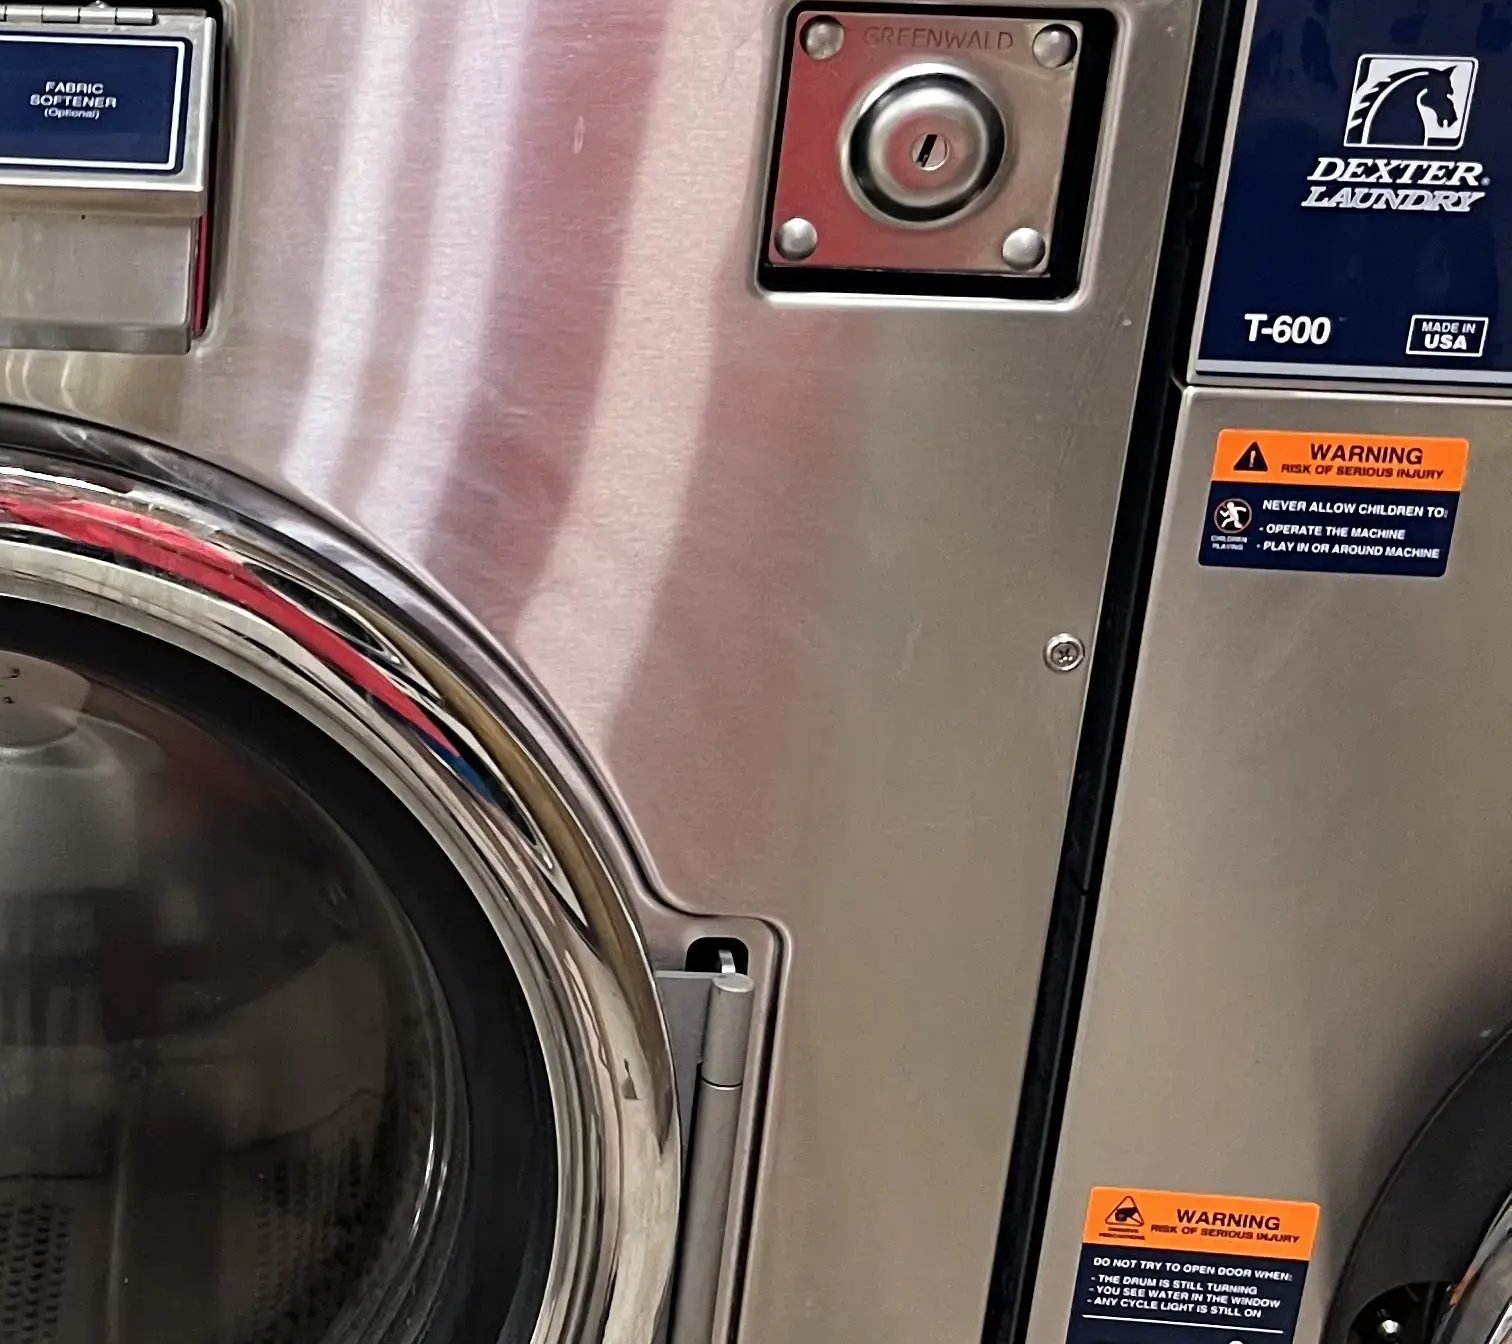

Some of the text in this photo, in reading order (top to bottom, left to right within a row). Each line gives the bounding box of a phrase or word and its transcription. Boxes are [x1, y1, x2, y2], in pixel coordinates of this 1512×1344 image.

[864, 26, 1013, 50] GREENWALD
[45, 81, 104, 94] FABRIC
[30, 94, 117, 108] SOFTENER
[44, 106, 100, 120] (Optional)
[1306, 157, 1483, 186] DEXTER
[1301, 186, 1486, 212] LAUNDRY
[1244, 313, 1331, 344] T-600
[1421, 321, 1476, 334] MADE IN
[1424, 332, 1468, 350] USA
[1310, 443, 1424, 466] WARNING
[1281, 464, 1444, 480] RISK OF SERIOUS INJURY
[1263, 500, 1448, 518] NEVER ALLOW CHILDREN TO:
[1266, 524, 1406, 540] OPERATE THE MACHINE
[1264, 541, 1440, 558] PLAY IN OR AROUND MACHINE
[1176, 1208, 1280, 1230] WARNING
[1150, 1224, 1178, 1234] RISK
[1181, 1226, 1198, 1235] OF
[1200, 1228, 1254, 1240] SERIOUS
[1256, 1231, 1300, 1243] INJURY
[1094, 1257, 1110, 1267] DO
[1113, 1258, 1137, 1268] NOT
[1140, 1260, 1162, 1271] TRY
[1166, 1262, 1180, 1272] TO
[1184, 1264, 1216, 1275] OPEN
[1218, 1266, 1252, 1278] DOOR
[1098, 1274, 1257, 1294] THE DRUM IS STILL TURNING
[1096, 1286, 1280, 1308] YOU SEE WATER IN THE WINDOW
